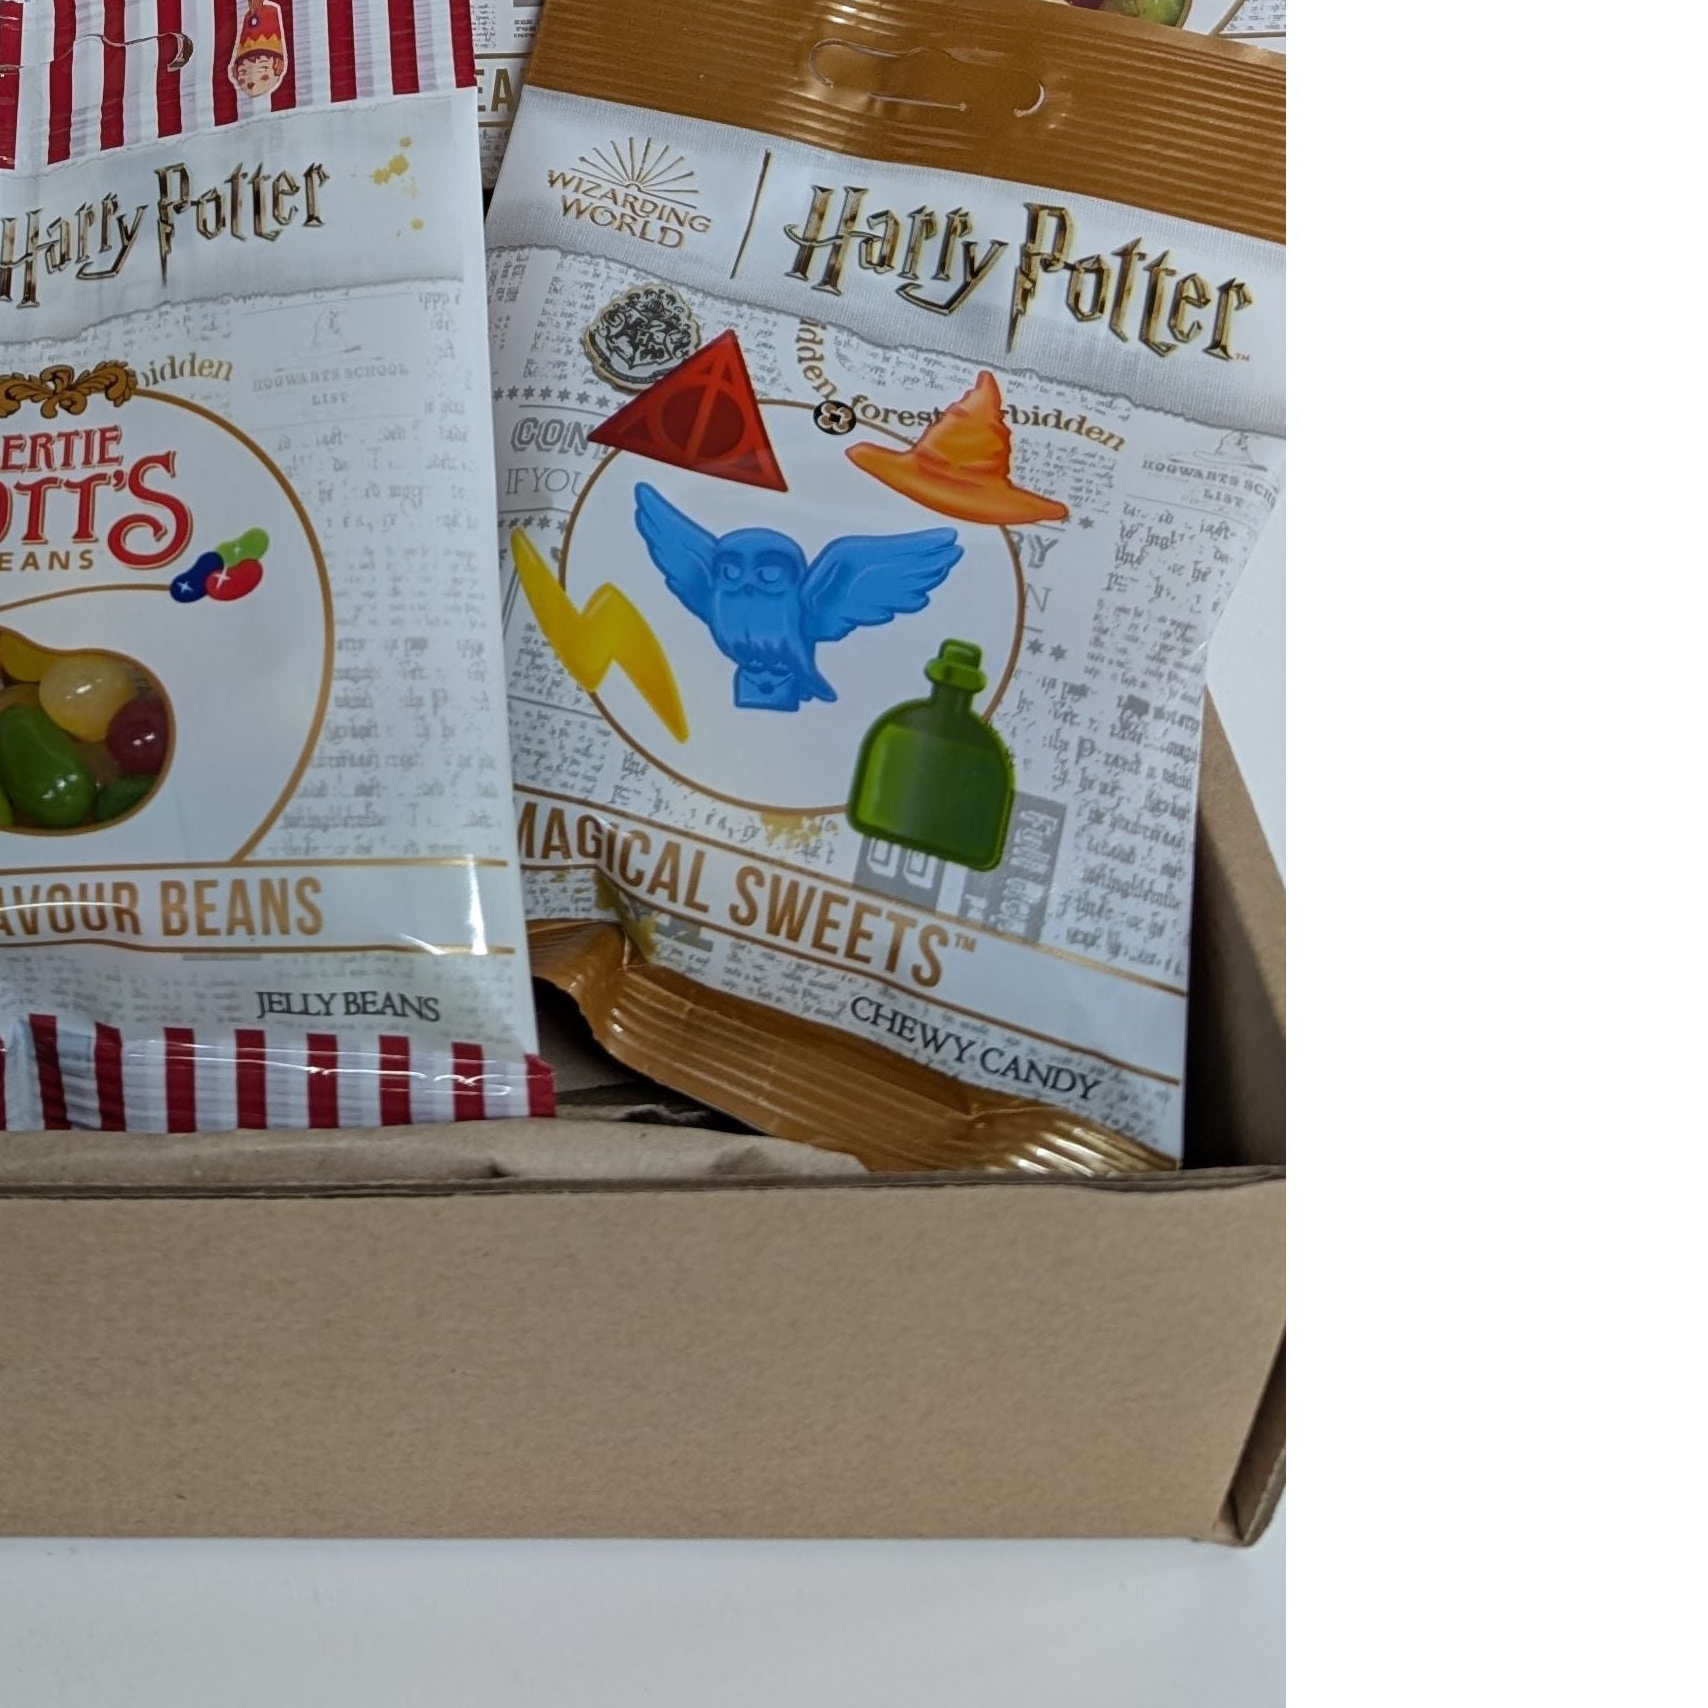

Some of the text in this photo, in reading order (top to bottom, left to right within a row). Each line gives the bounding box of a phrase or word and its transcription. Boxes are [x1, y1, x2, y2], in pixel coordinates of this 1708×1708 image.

[154, 162, 331, 287] Potter
[547, 168, 712, 235] WIZARDING
[560, 194, 686, 250] WORLD
[784, 185, 1253, 361] Harry Potter
[253, 363, 409, 392] HOGWARTS SCHOOL
[311, 393, 348, 407] LIST
[1142, 459, 1239, 486] HOGWARTS
[1203, 489, 1245, 509] LIST
[160, 876, 323, 937] BEANS
[256, 991, 442, 1022] JELLY BEANS
[850, 994, 1105, 1101] CHEWY CANDY
